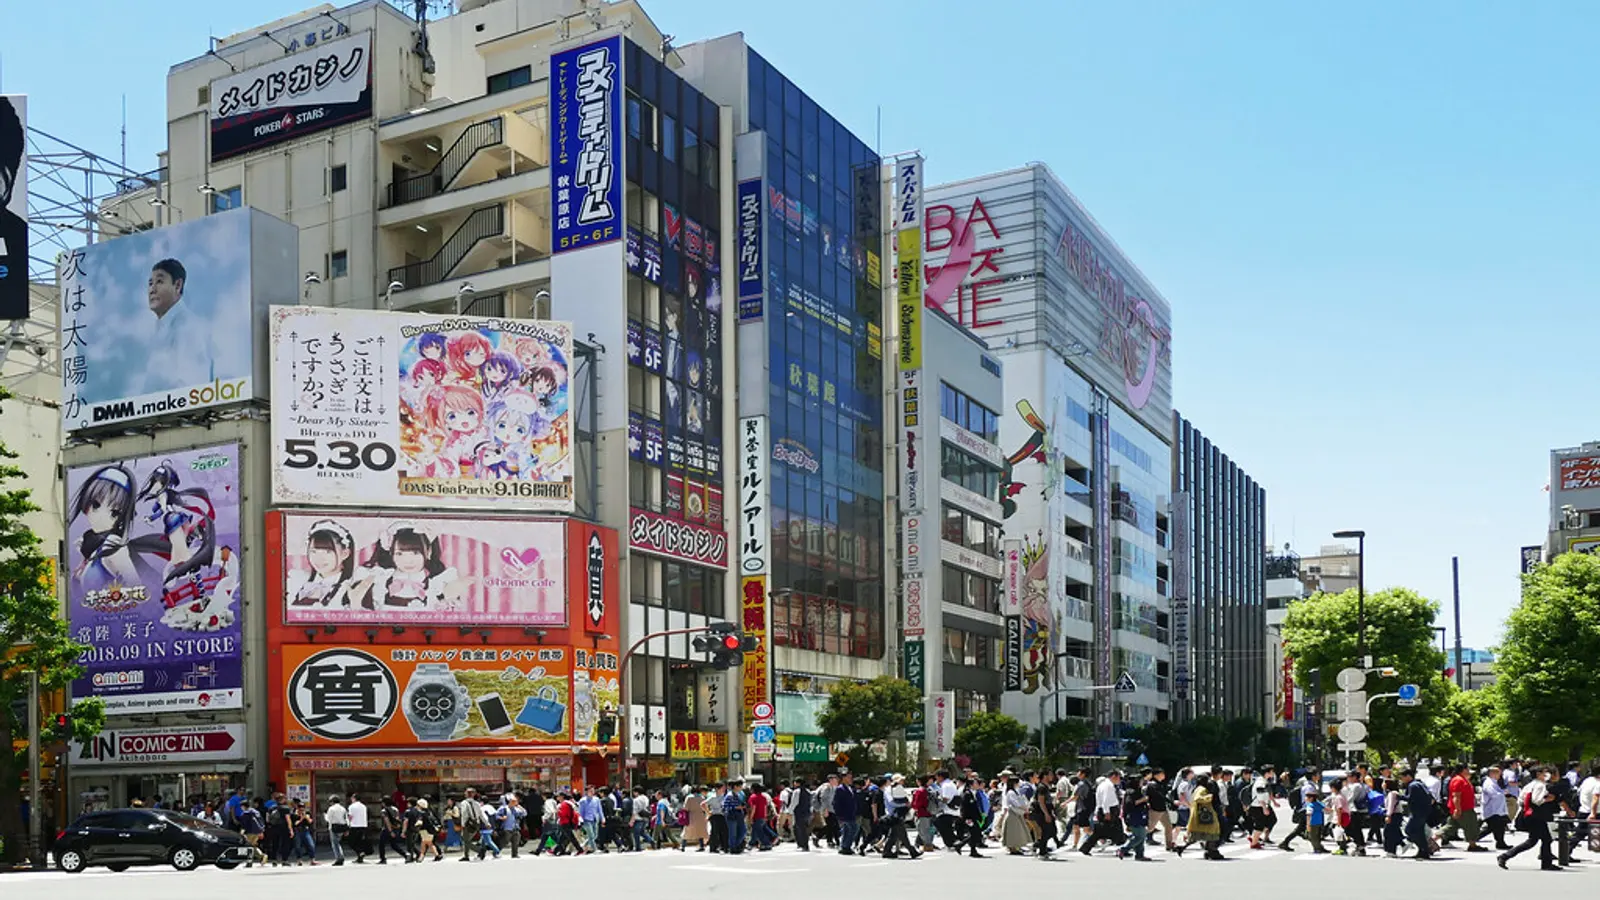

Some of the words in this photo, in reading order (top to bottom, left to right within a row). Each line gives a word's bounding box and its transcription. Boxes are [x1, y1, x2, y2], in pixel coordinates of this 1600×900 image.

[219, 47, 364, 117] メイドカジノ
[254, 121, 281, 137] POKER
[296, 108, 324, 124] STARS
[558, 176, 570, 229] 秋葉原店
[644, 258, 661, 281] 7F
[901, 259, 912, 296] Yellow
[62, 250, 88, 428] 次は太陽か。
[902, 303, 914, 364] Submarine
[329, 332, 348, 395] うさぎ
[645, 348, 662, 370] 6F
[352, 337, 374, 415] ご注文は
[904, 371, 917, 379] 5F
[189, 378, 246, 406] solar
[327, 416, 346, 428] My
[283, 439, 396, 472] 5.30
[645, 441, 662, 461] 5F
[405, 484, 435, 494] DMS
[632, 515, 726, 563] メイドカジノ
[908, 518, 919, 571] amiami
[531, 578, 556, 587] cafe
[743, 580, 765, 631] 免税
[78, 645, 139, 664] 2018.09
[147, 642, 166, 657] IN
[174, 636, 235, 656] STORE
[391, 650, 417, 661] 時計
[421, 650, 454, 661] バッグ
[460, 650, 497, 661] 貴金属
[500, 650, 535, 661] ダイヤ
[538, 650, 563, 661] 携帯
[755, 636, 765, 664] TAX
[1008, 619, 1019, 688] GALLERIA
[92, 670, 144, 687] amiami
[302, 662, 385, 729] 質
[121, 736, 176, 753] COMIC
[181, 735, 205, 751] ZIN
